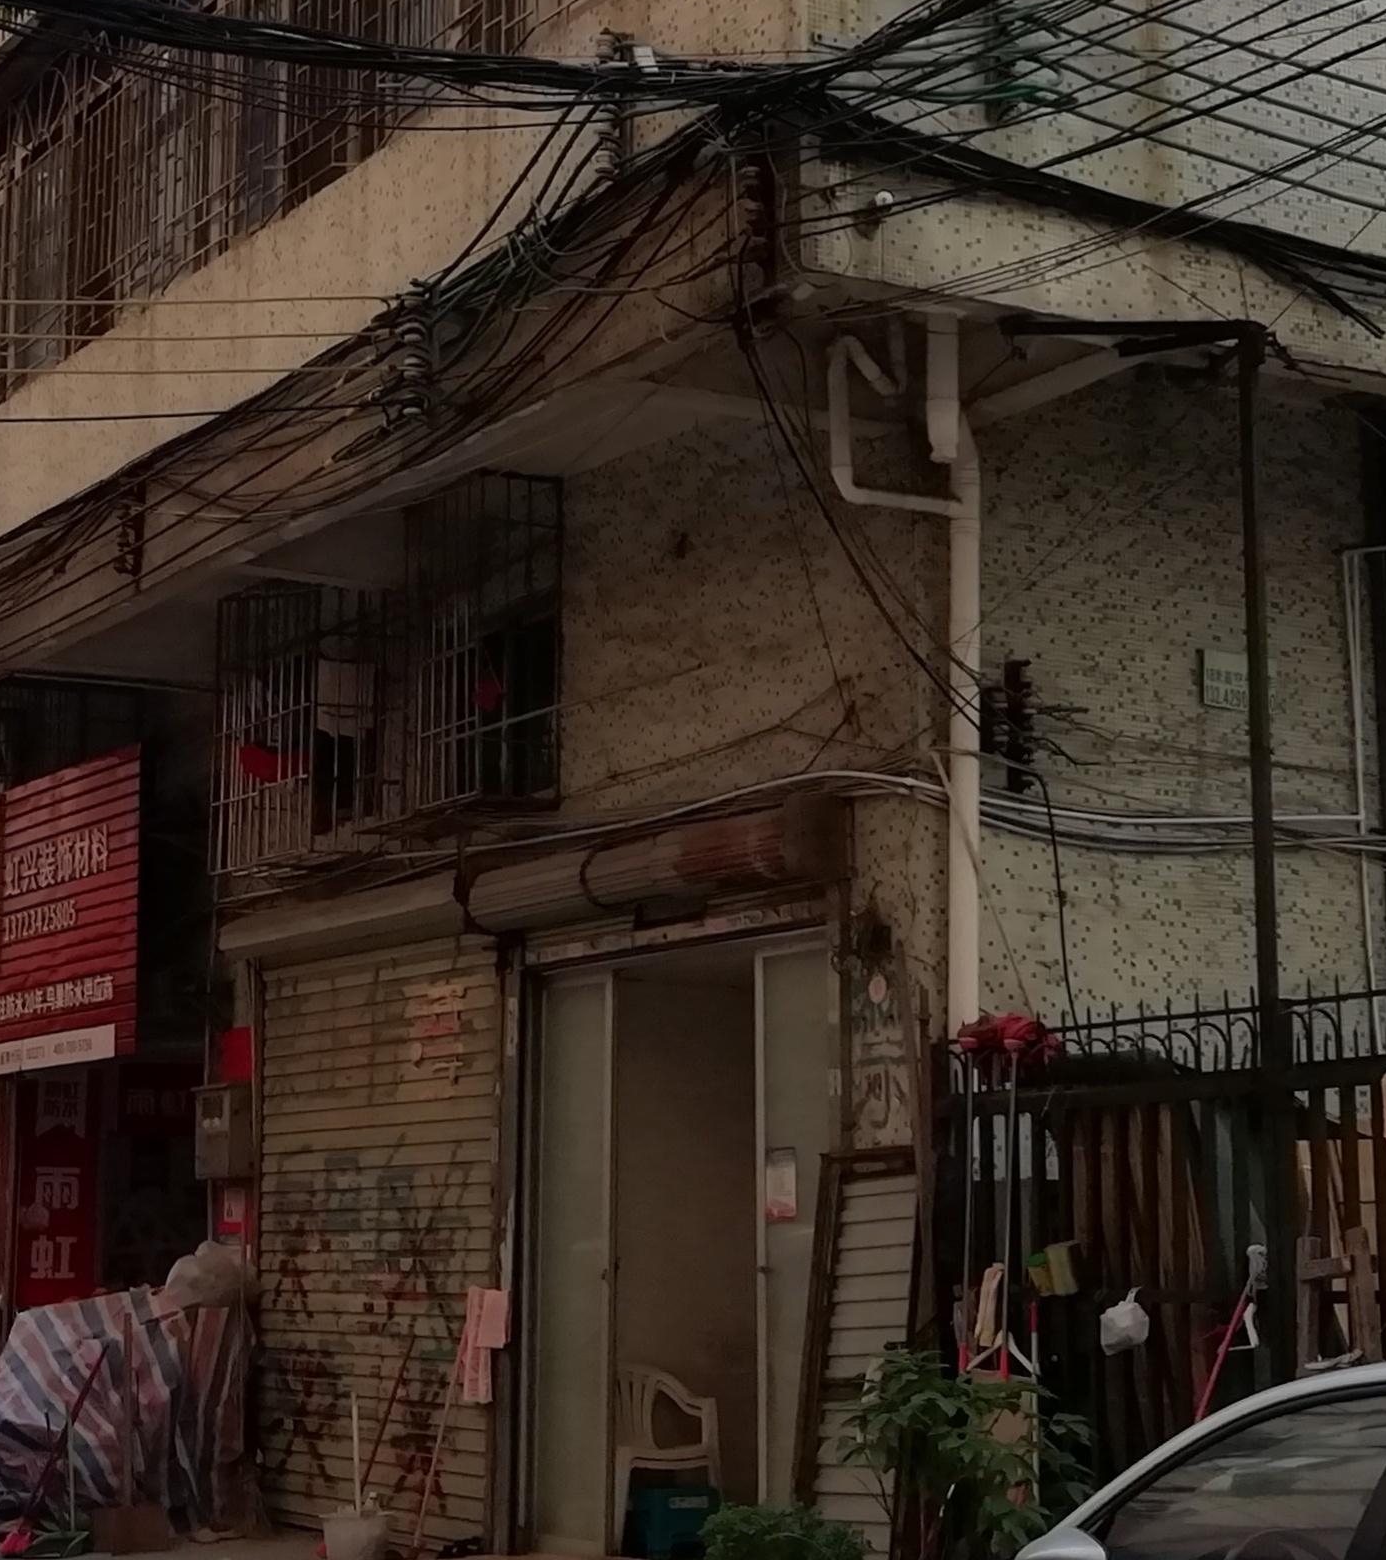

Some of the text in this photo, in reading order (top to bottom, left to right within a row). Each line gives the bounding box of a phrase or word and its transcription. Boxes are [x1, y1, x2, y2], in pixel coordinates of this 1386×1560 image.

[4, 824, 109, 898] 虹兴装饰材料
